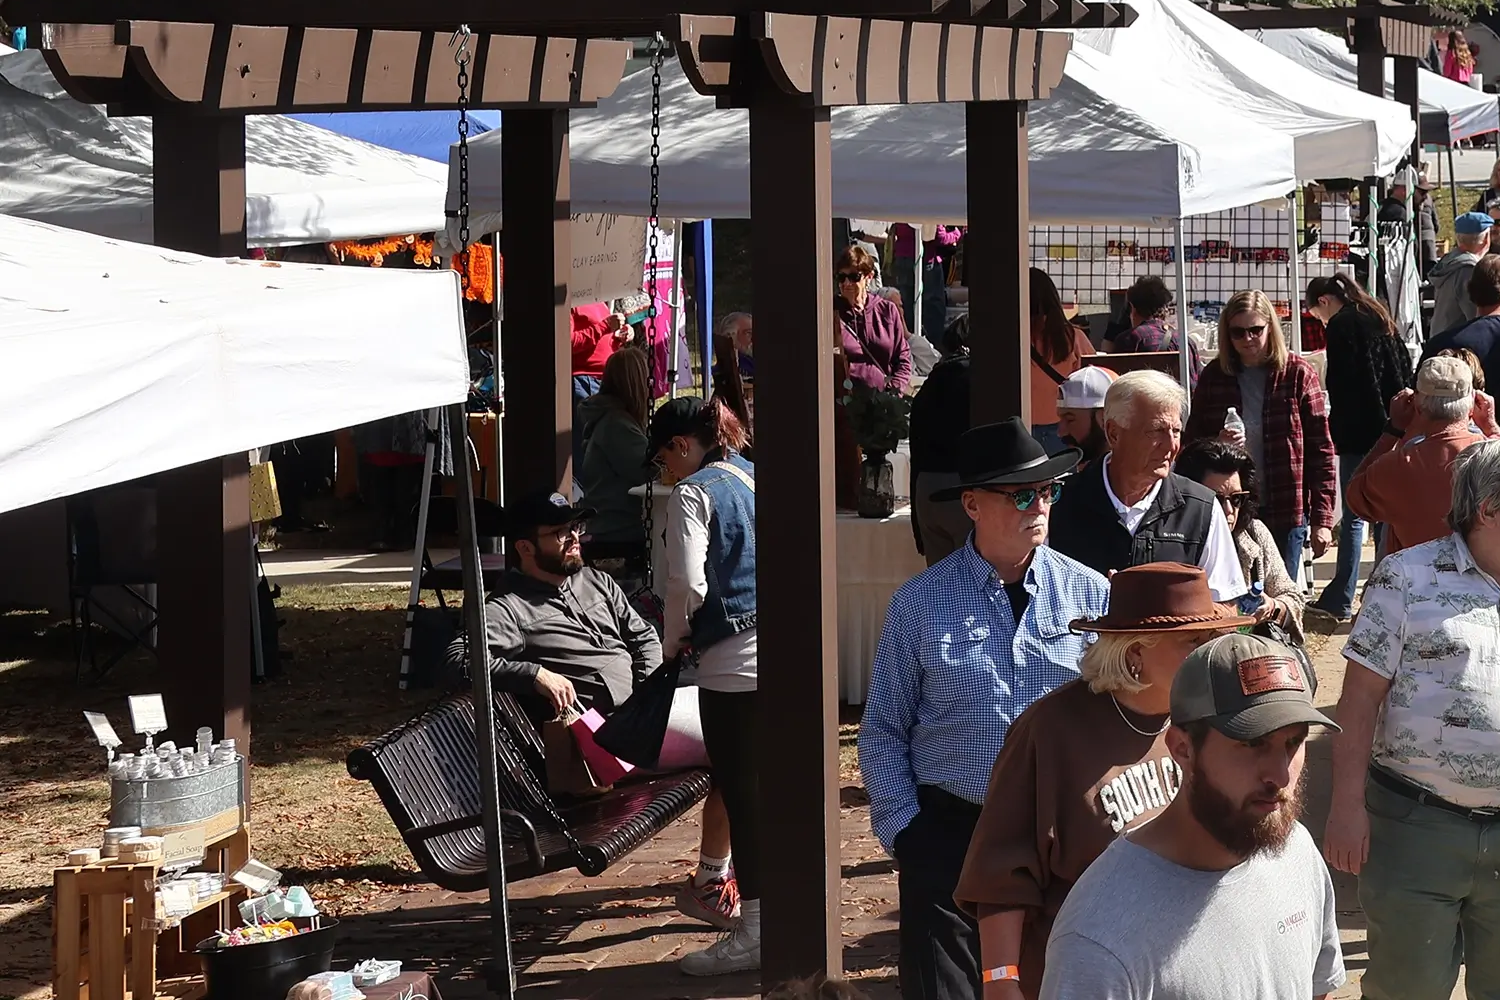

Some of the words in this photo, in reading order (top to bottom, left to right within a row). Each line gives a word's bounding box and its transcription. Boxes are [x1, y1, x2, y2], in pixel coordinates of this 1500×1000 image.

[1100, 760, 1167, 832] SOUTH
[164, 848, 185, 859] Facial
[186, 845, 203, 855] Soap
